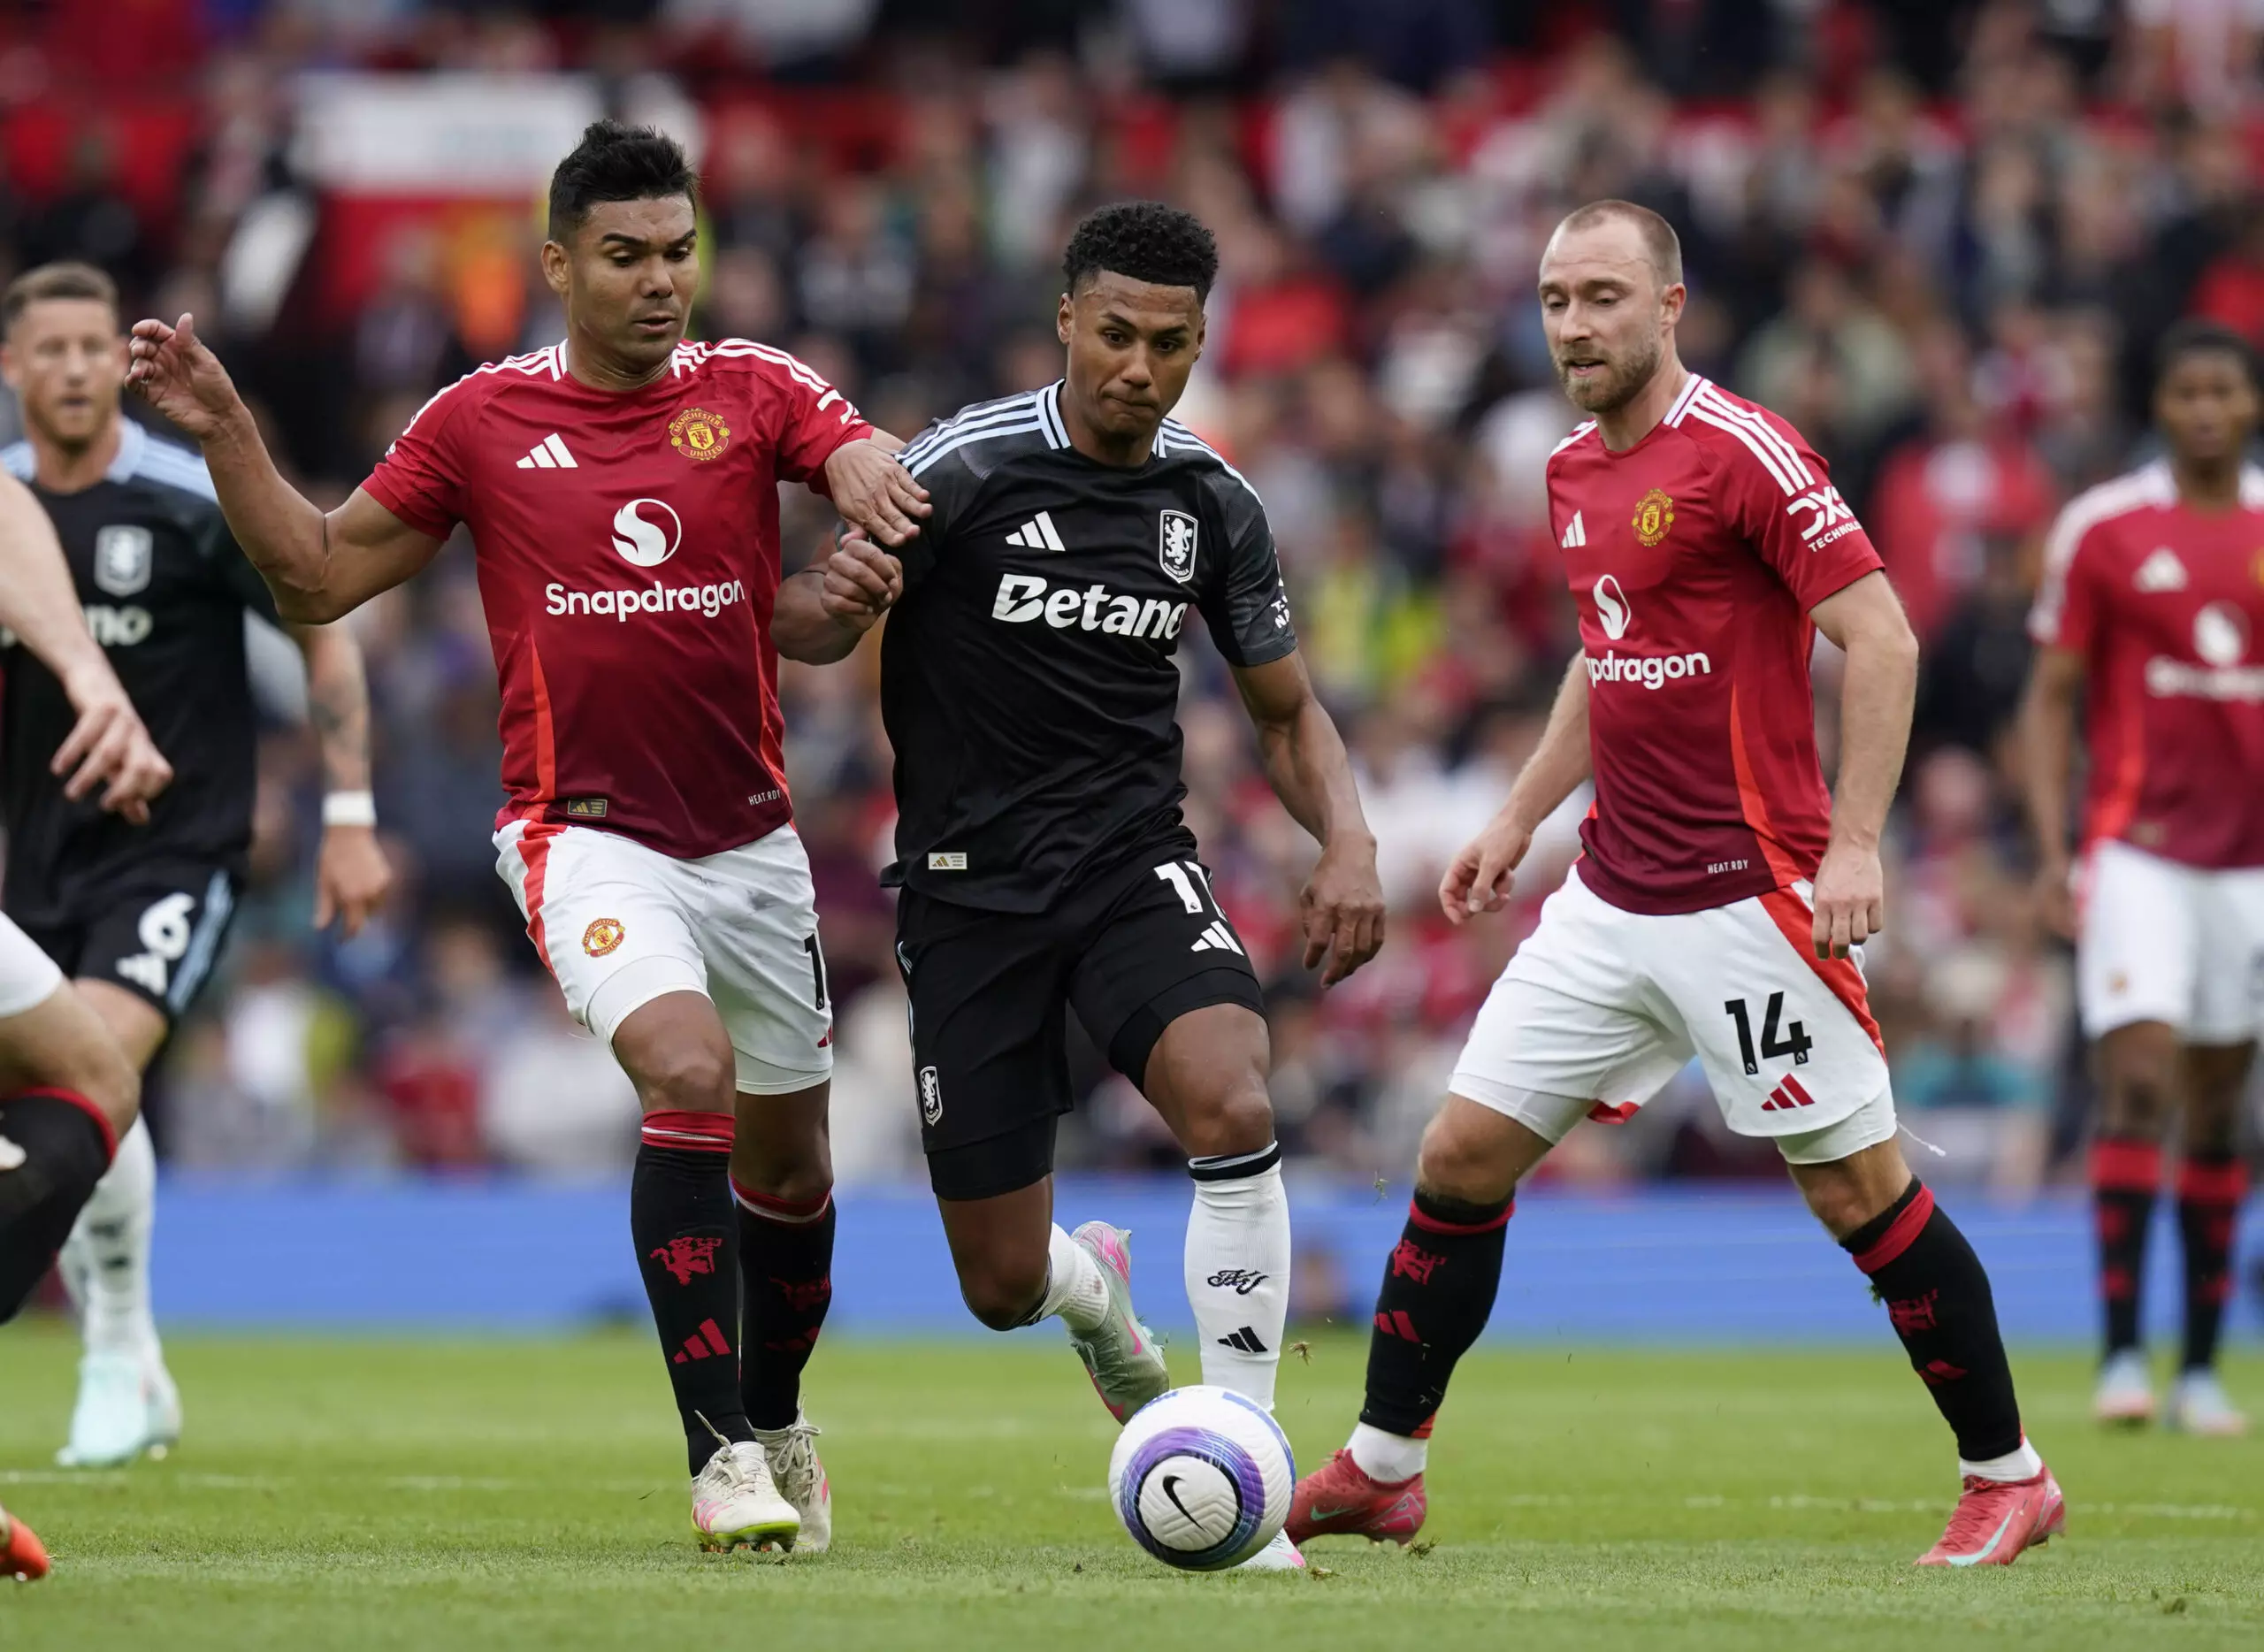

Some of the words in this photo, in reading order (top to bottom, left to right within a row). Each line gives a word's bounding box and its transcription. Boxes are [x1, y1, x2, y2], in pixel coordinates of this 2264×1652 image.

[674, 412, 721, 433] MANCHESTER
[690, 445, 723, 457] UNITED
[545, 579, 746, 623] Snapdragon
[991, 573, 1189, 640] Betano
[1585, 649, 1712, 691] pdragon
[1707, 860, 1748, 875] HEAT.RDY
[139, 891, 195, 960] 6
[1724, 991, 1813, 1075] 14
